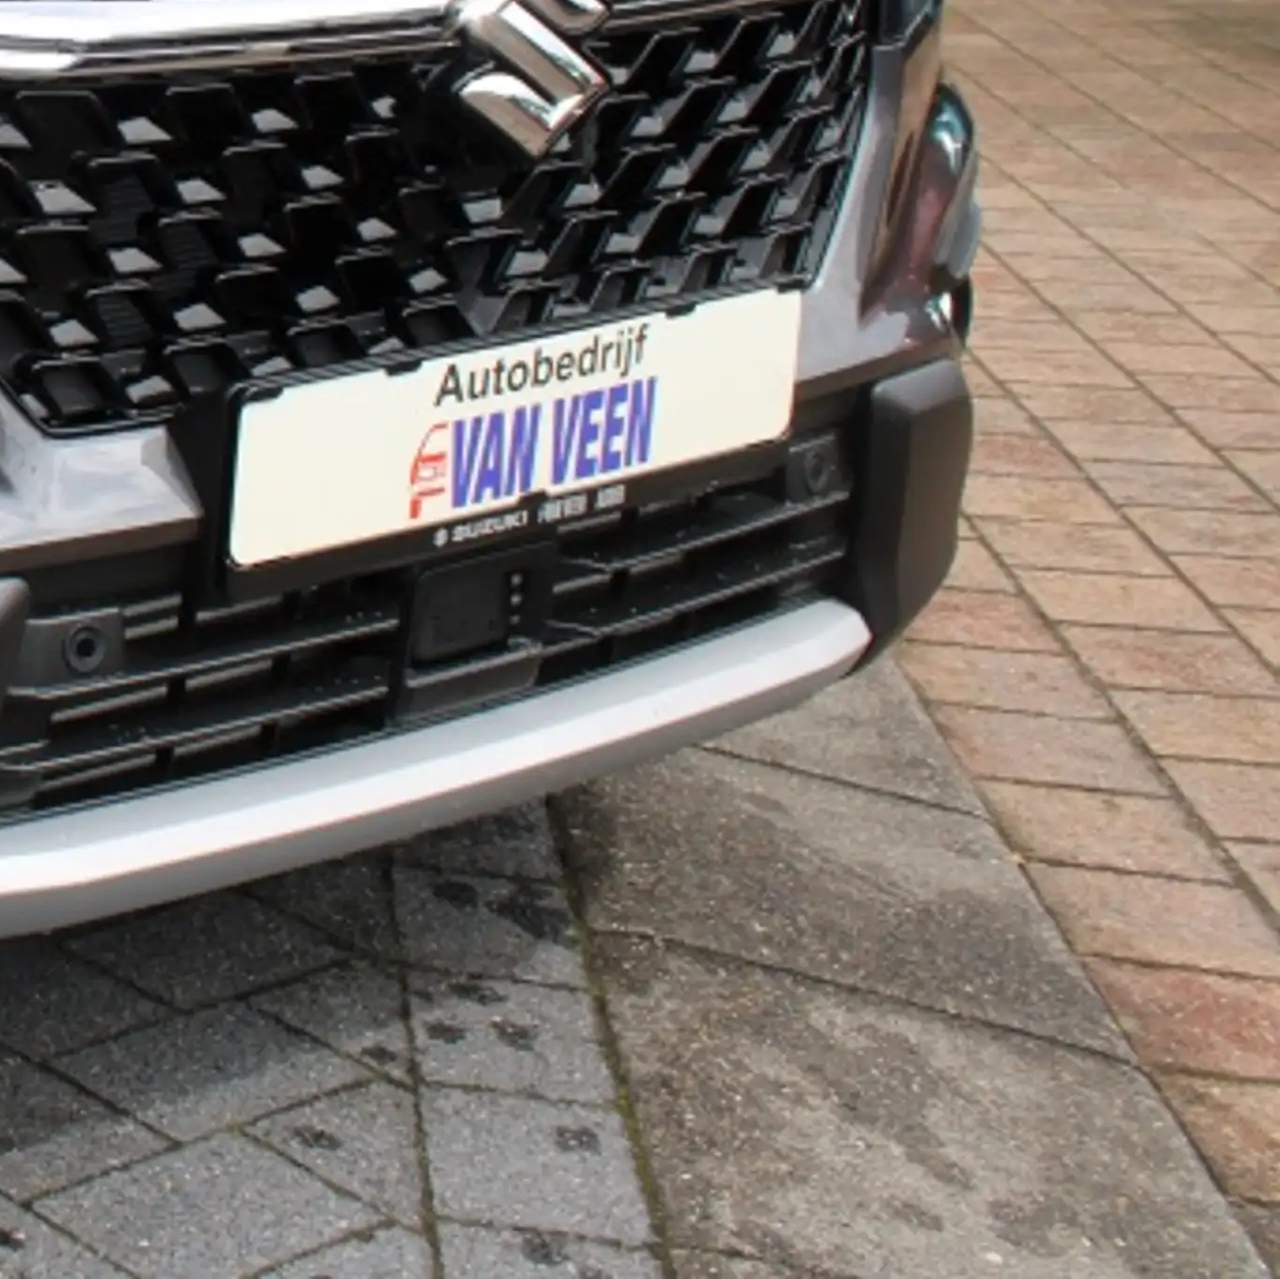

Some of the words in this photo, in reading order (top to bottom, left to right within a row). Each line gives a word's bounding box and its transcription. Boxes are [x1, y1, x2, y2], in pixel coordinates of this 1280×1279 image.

[434, 324, 649, 406] Autobedrijf
[452, 404, 542, 508] VAN
[552, 377, 657, 485] VEEN
